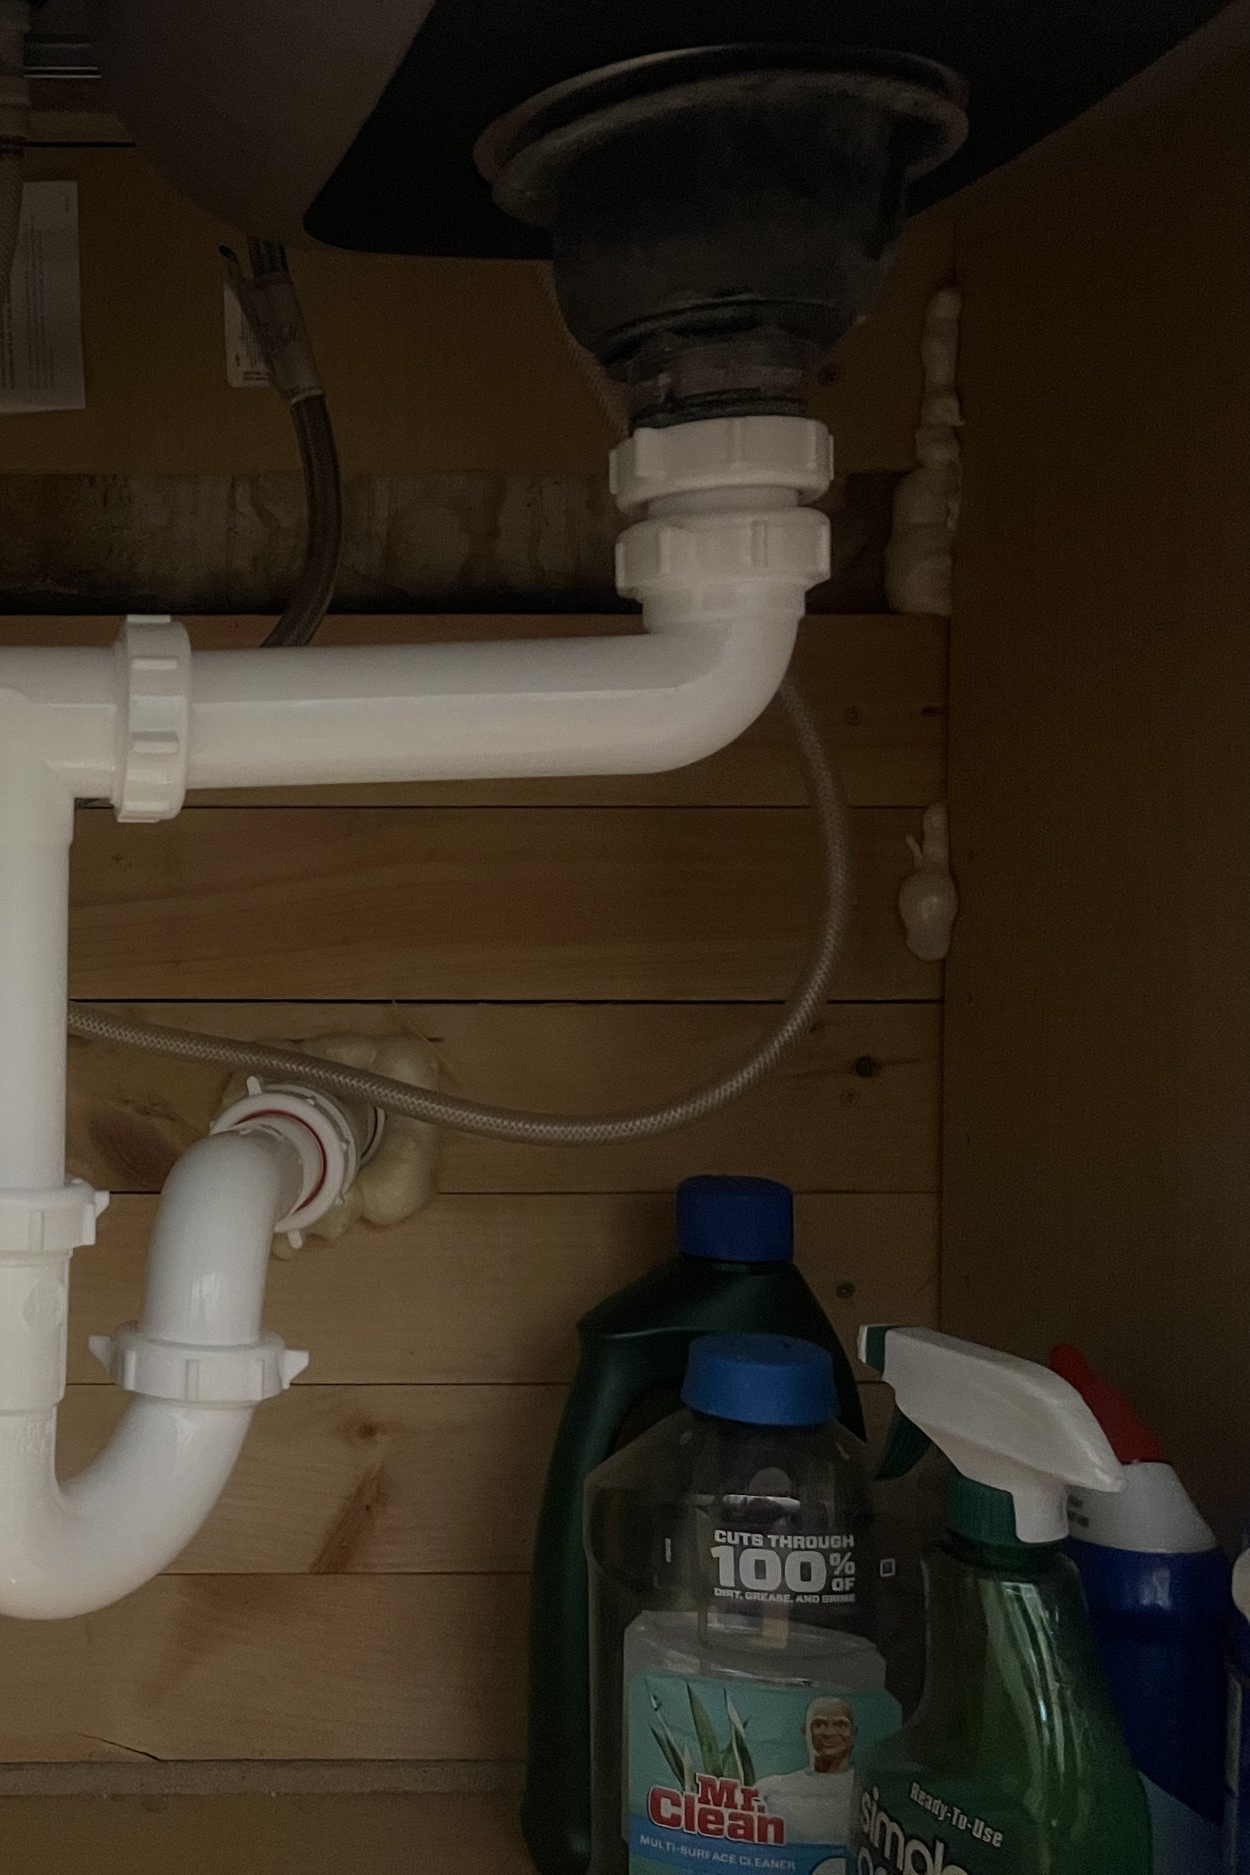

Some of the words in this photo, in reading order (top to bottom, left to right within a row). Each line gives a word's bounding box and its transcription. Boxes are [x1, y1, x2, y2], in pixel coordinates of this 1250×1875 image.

[714, 1529, 764, 1547] CUTS
[766, 1533, 855, 1549] THROUGH
[713, 1587, 743, 1600] DIRT,
[795, 1593, 820, 1604] AND
[821, 1592, 857, 1604] GRIME
[831, 1576, 856, 1592] OF
[696, 1772, 767, 1814] Mr.
[647, 1784, 787, 1847] Clean
[861, 1785, 969, 1875] simpl
[909, 1781, 1004, 1848] Ready-To-Use
[639, 1833, 737, 1865] MULTI-SURFACE
[738, 1855, 797, 1871] CLEANER
